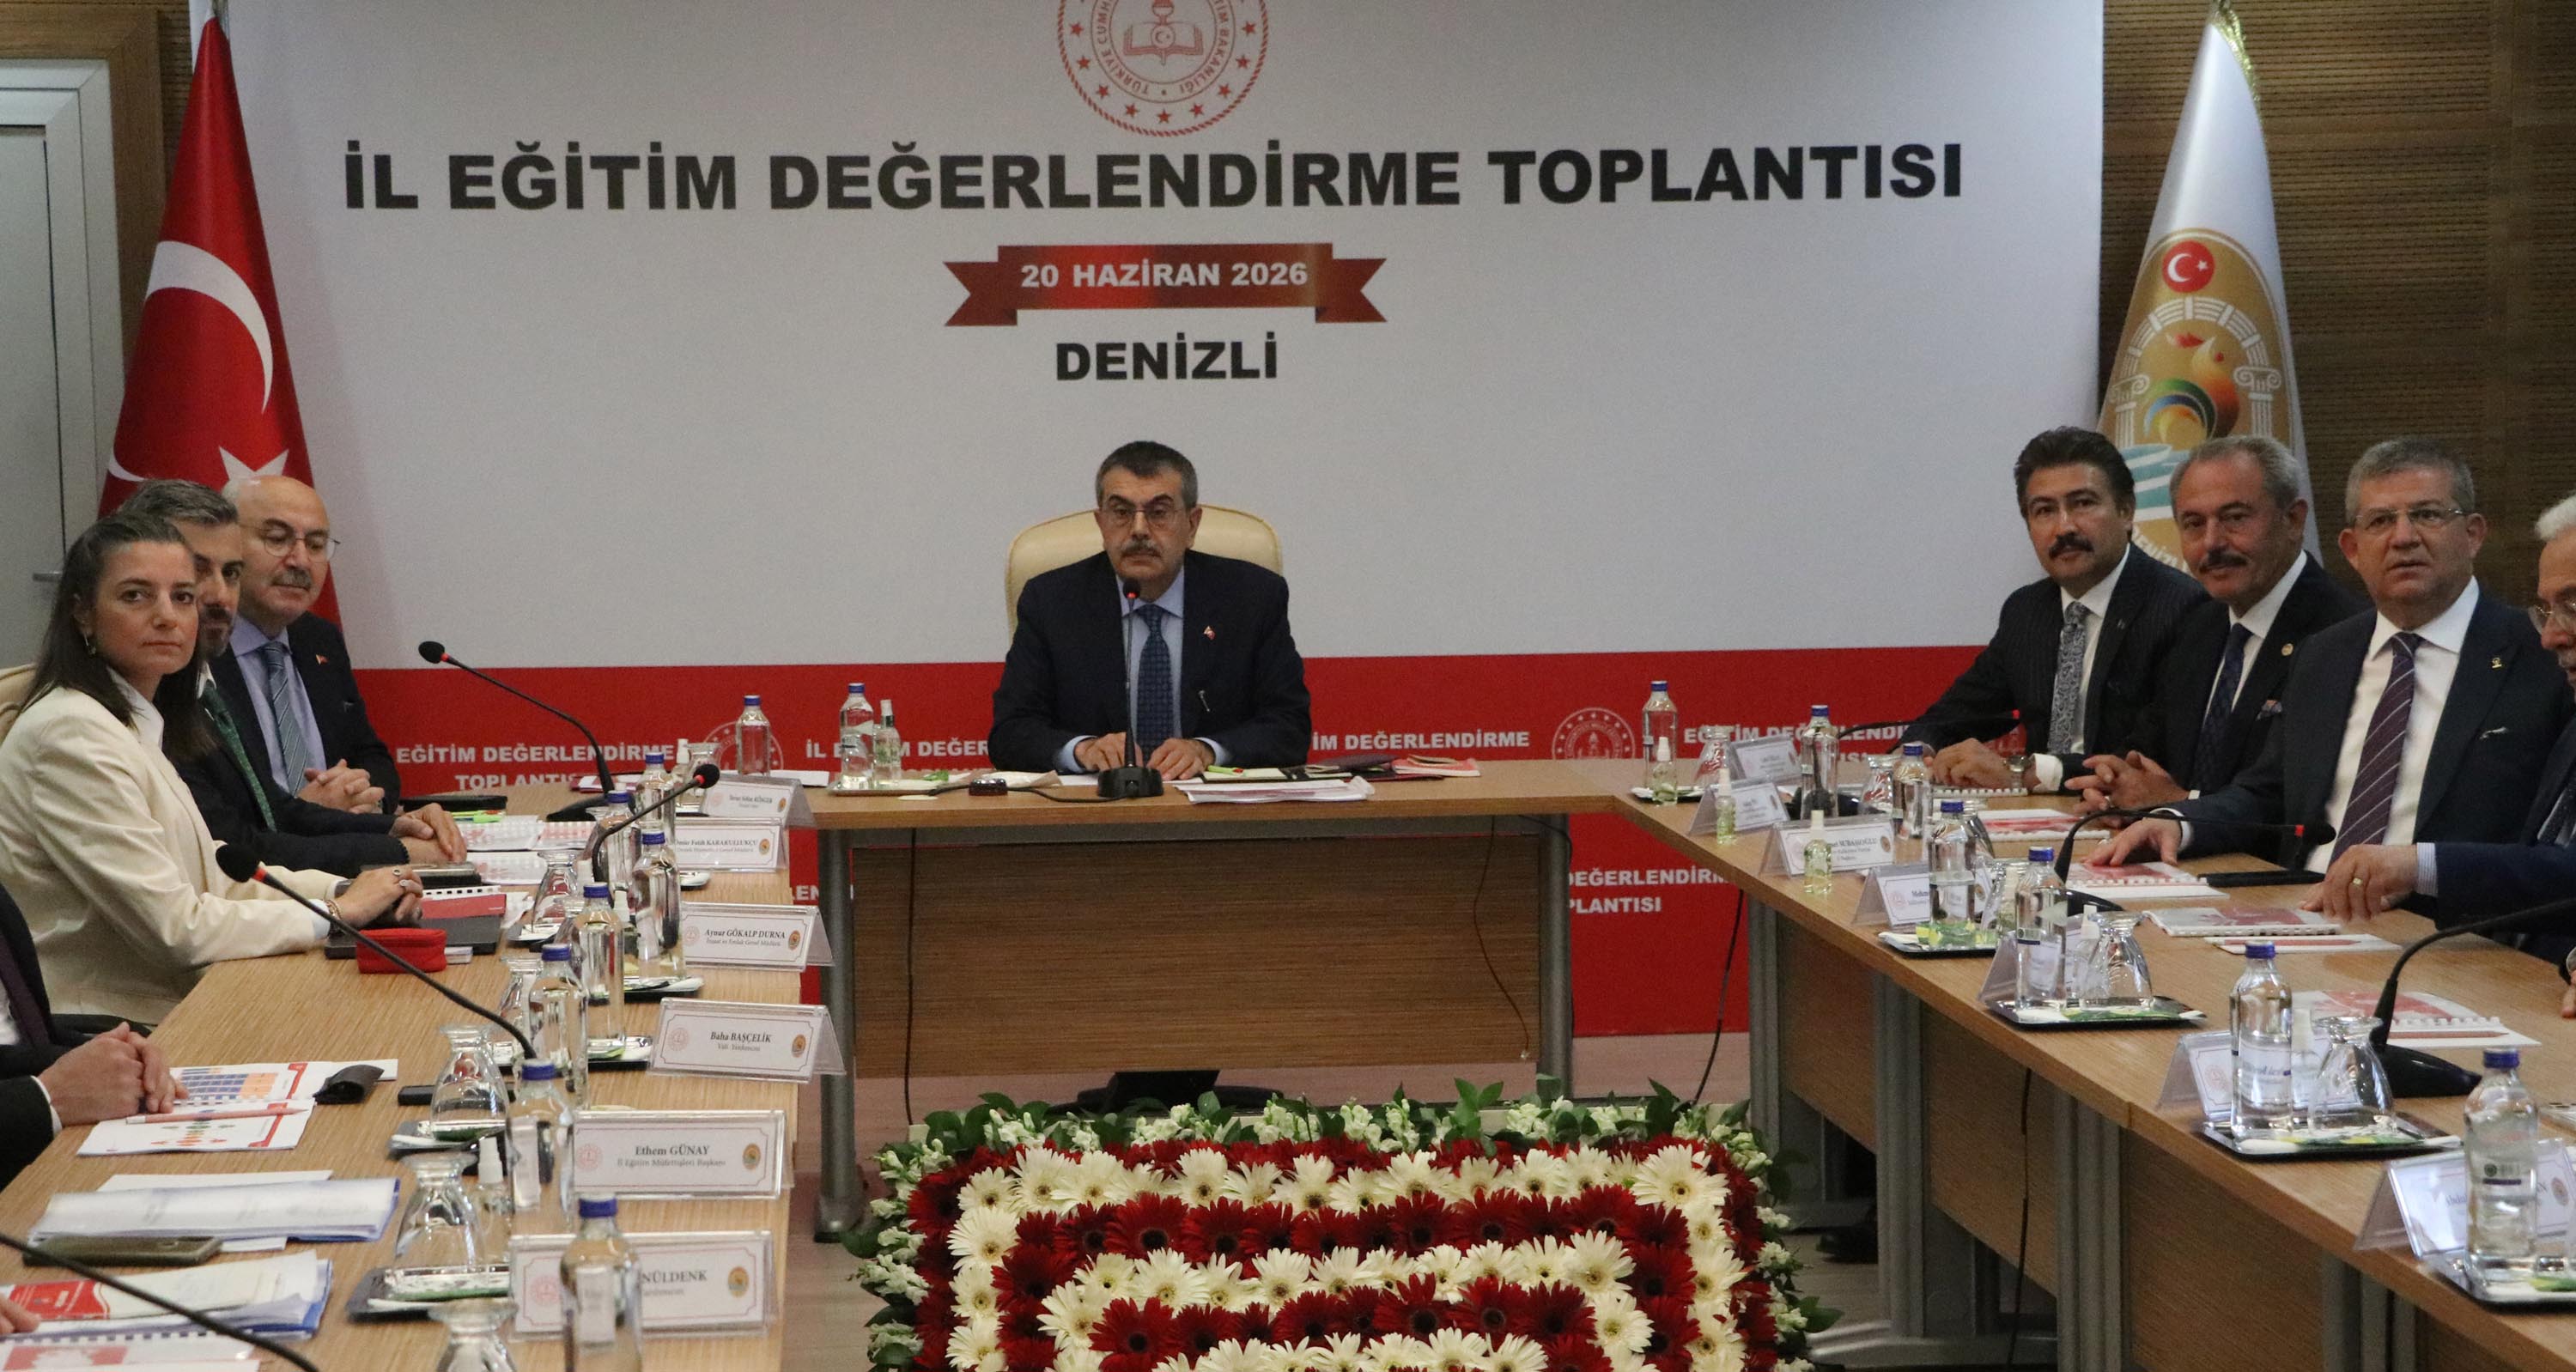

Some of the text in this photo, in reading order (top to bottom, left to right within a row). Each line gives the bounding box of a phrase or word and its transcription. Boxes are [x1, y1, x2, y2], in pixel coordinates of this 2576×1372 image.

[345, 140, 1960, 209] İL EĞİTİM DEĞERLENDİRME TOPLANTISI
[1023, 260, 1307, 286] 20 HAZİRAN 2026
[1057, 331, 1276, 380] DENİZLİ
[807, 740, 826, 757] İL
[1346, 730, 1528, 750] DEĞERLENDİRME
[398, 744, 475, 762] EĞİTİM
[706, 928, 786, 939] Aynur GÖKALP DURNA
[710, 1031, 772, 1043] Baha BAŞÇELİK
[635, 1144, 710, 1156] Ethem GÜNAY
